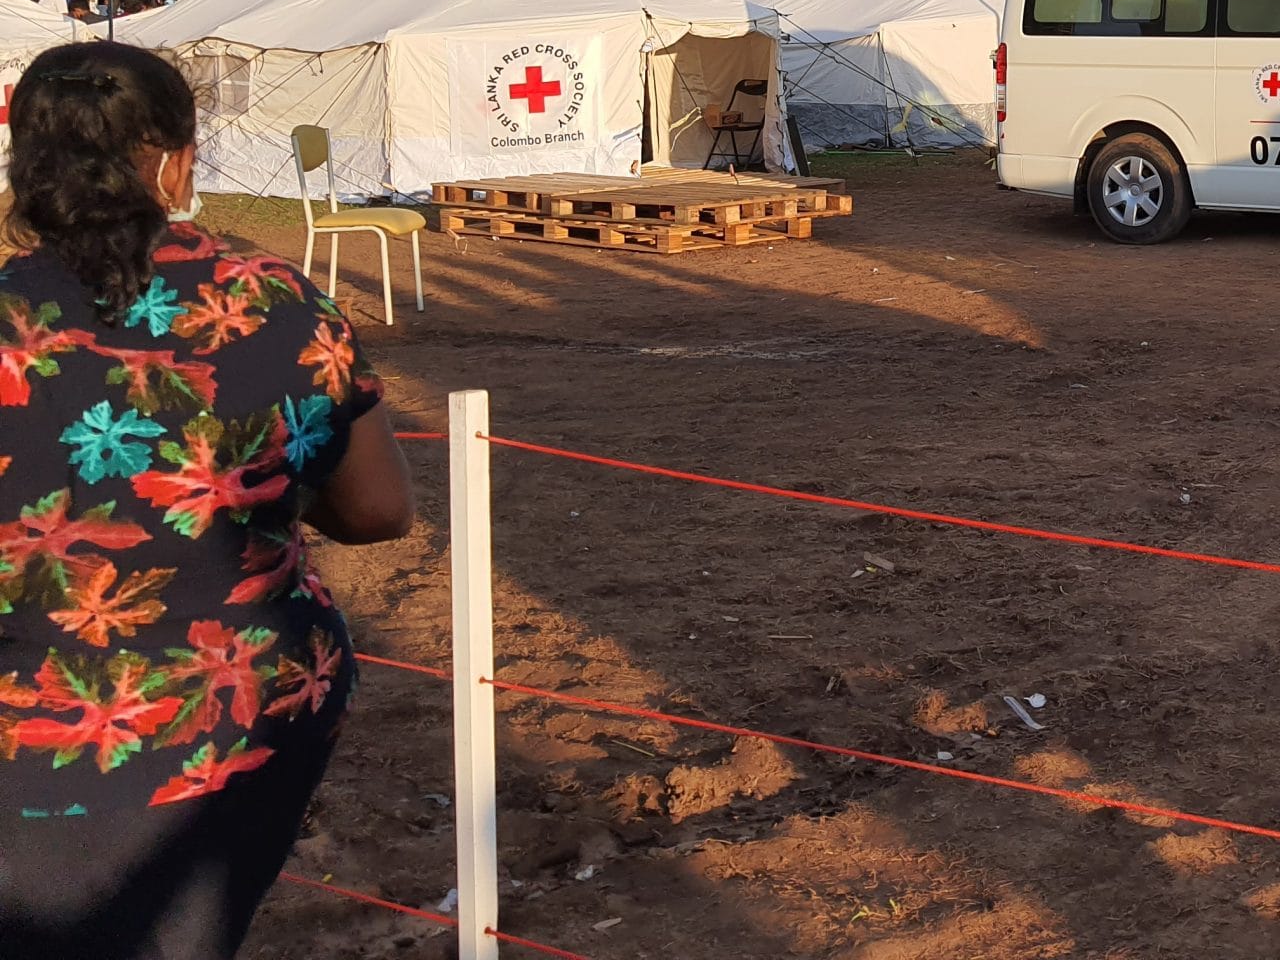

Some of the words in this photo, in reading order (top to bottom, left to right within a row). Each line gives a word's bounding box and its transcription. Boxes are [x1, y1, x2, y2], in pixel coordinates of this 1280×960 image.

[502, 46, 530, 64] RED
[535, 44, 578, 70] CROSS
[486, 66, 504, 112] LANKA
[558, 72, 584, 128] SOCIETY
[497, 113, 519, 132] SRI
[491, 135, 541, 147] Colombo
[545, 130, 584, 143] Branch
